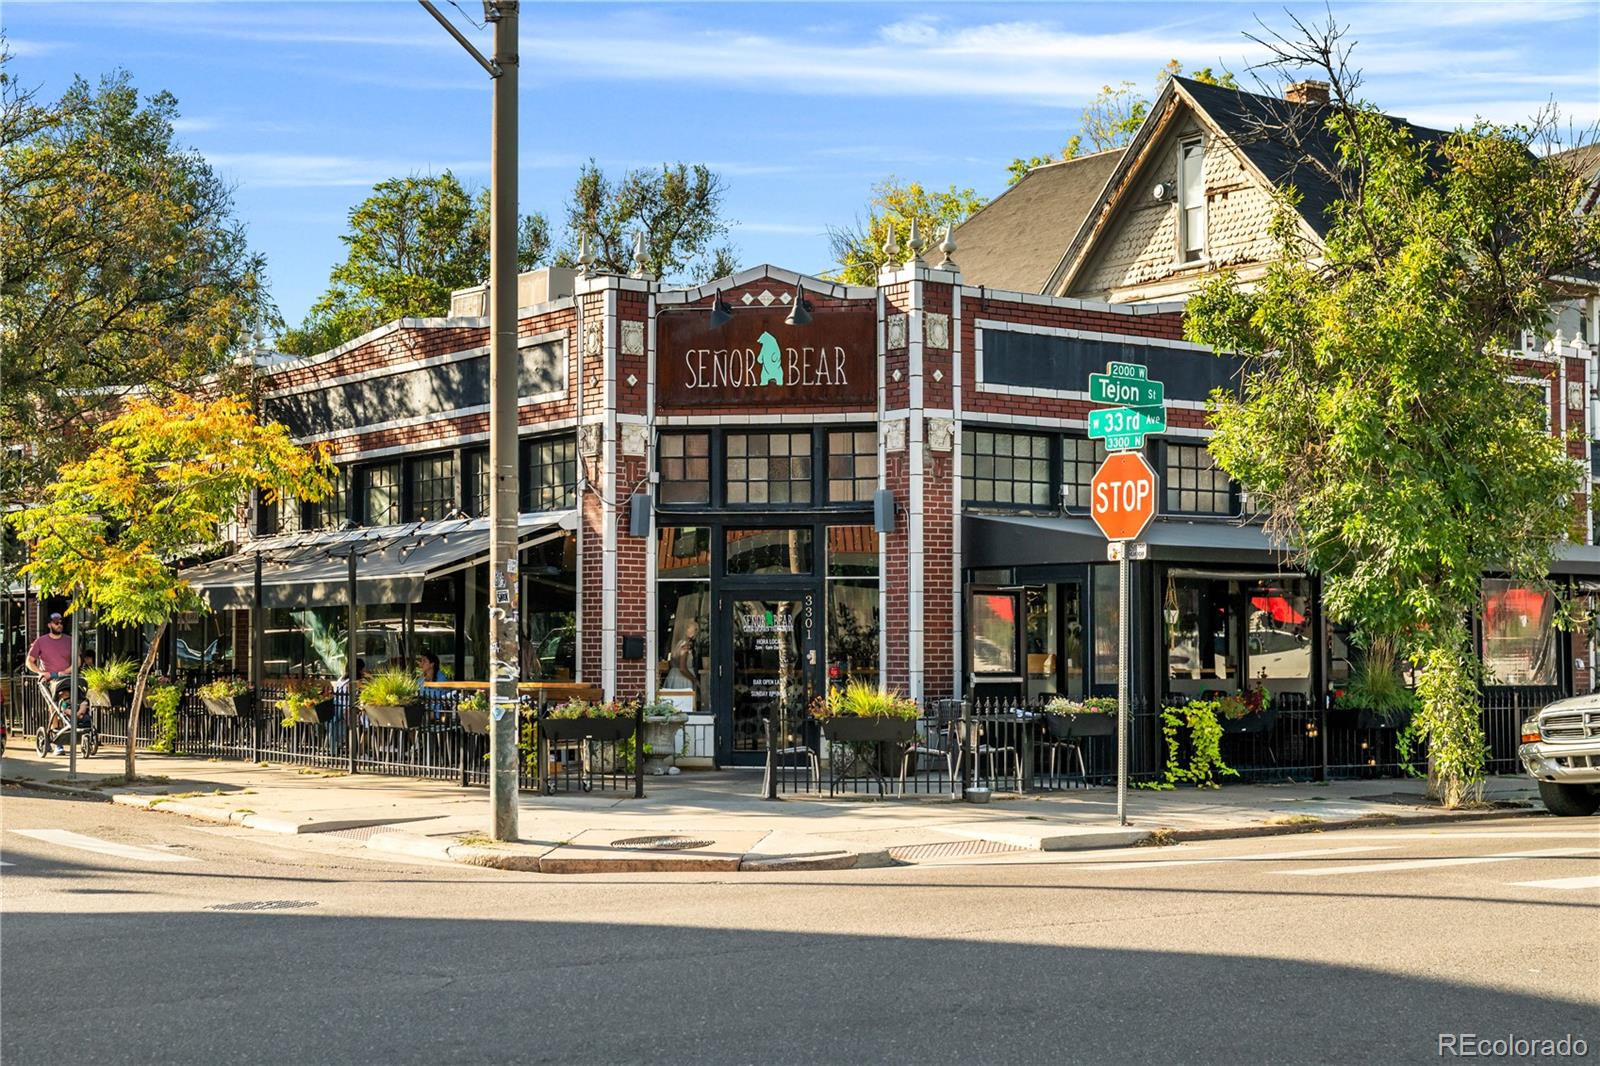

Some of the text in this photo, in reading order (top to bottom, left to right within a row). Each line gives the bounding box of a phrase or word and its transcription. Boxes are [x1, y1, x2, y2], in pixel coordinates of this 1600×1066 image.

[685, 346, 848, 389] SEÑOR BEAR
[1112, 364, 1146, 379] 2000 W
[1098, 378, 1157, 402] Tejon St
[1093, 412, 1161, 433] W 33rd Ave
[1107, 436, 1141, 448] 3300 N
[1096, 479, 1150, 514] STOP
[773, 614, 794, 627] BEAR
[804, 594, 814, 640] 3301
